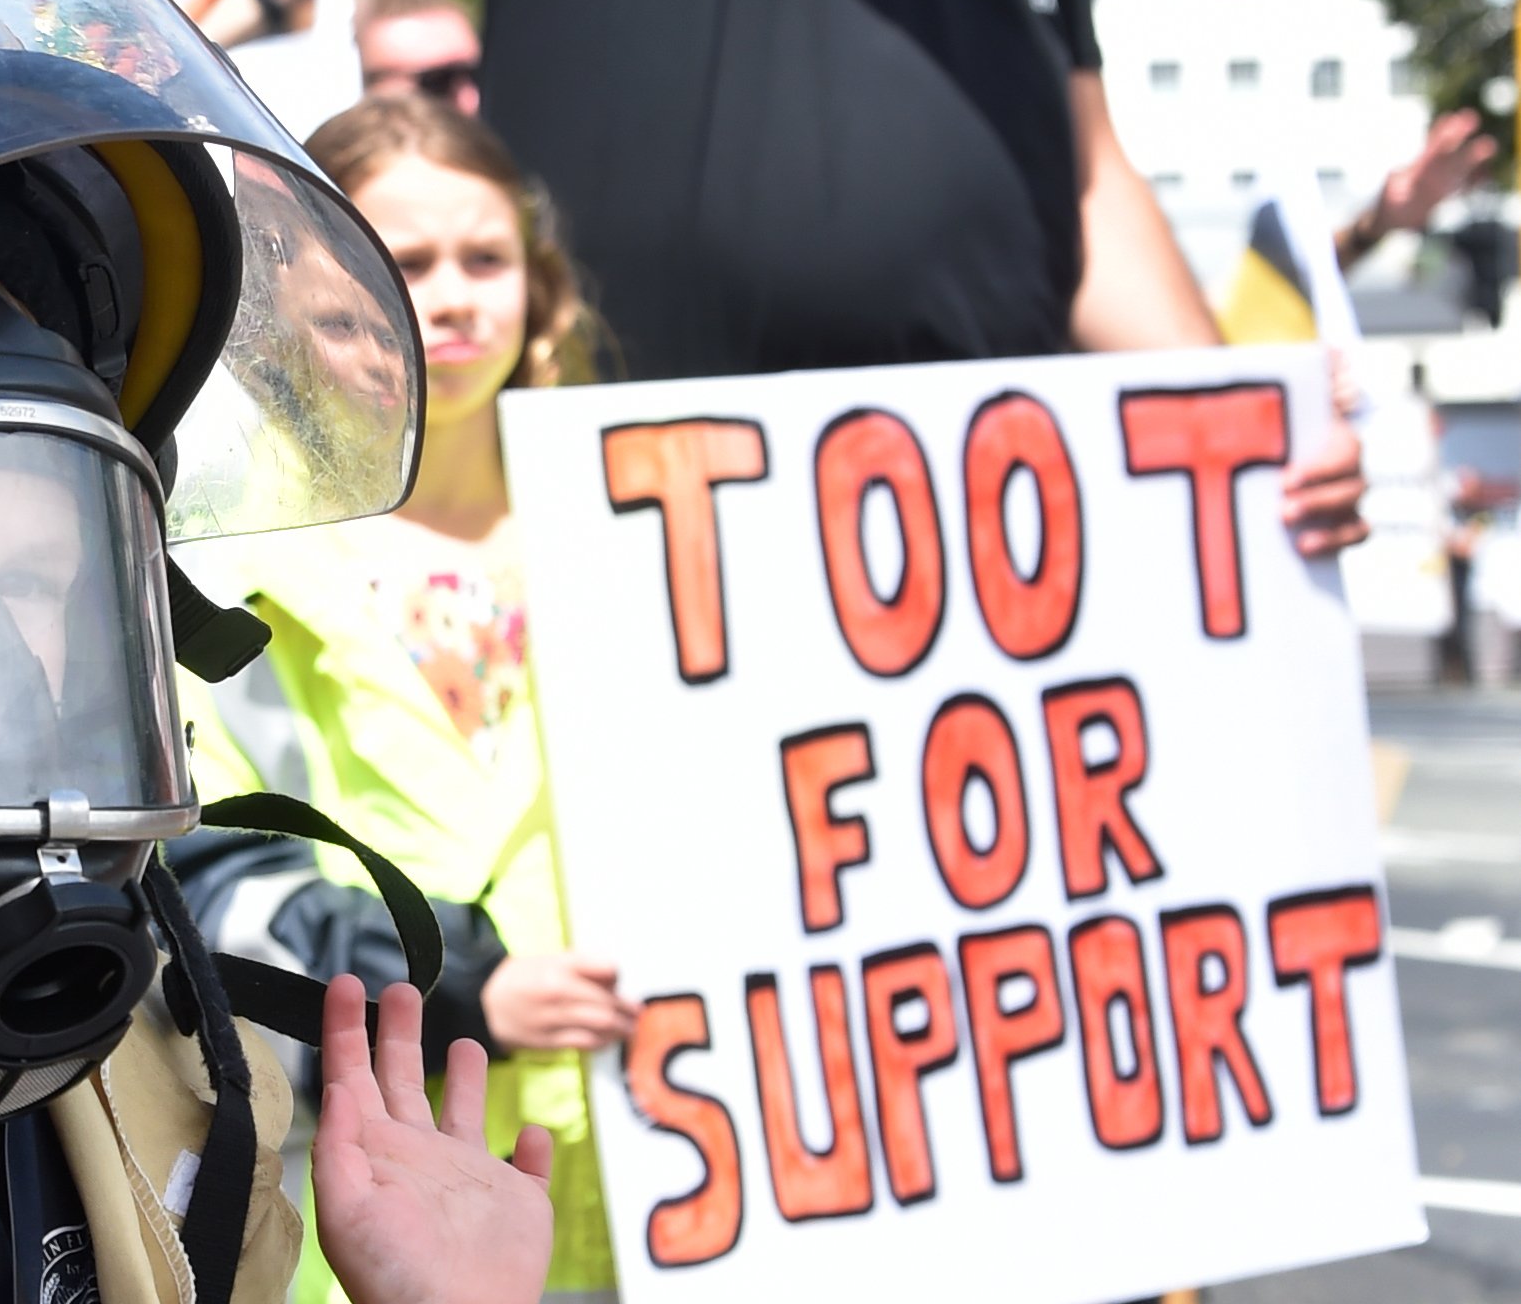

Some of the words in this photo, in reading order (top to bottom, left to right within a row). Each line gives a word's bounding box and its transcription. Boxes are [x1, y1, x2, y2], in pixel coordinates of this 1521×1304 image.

[601, 384, 1288, 684] TOOT
[780, 676, 1164, 933] FOR
[623, 886, 1381, 1268] SUPPORT
